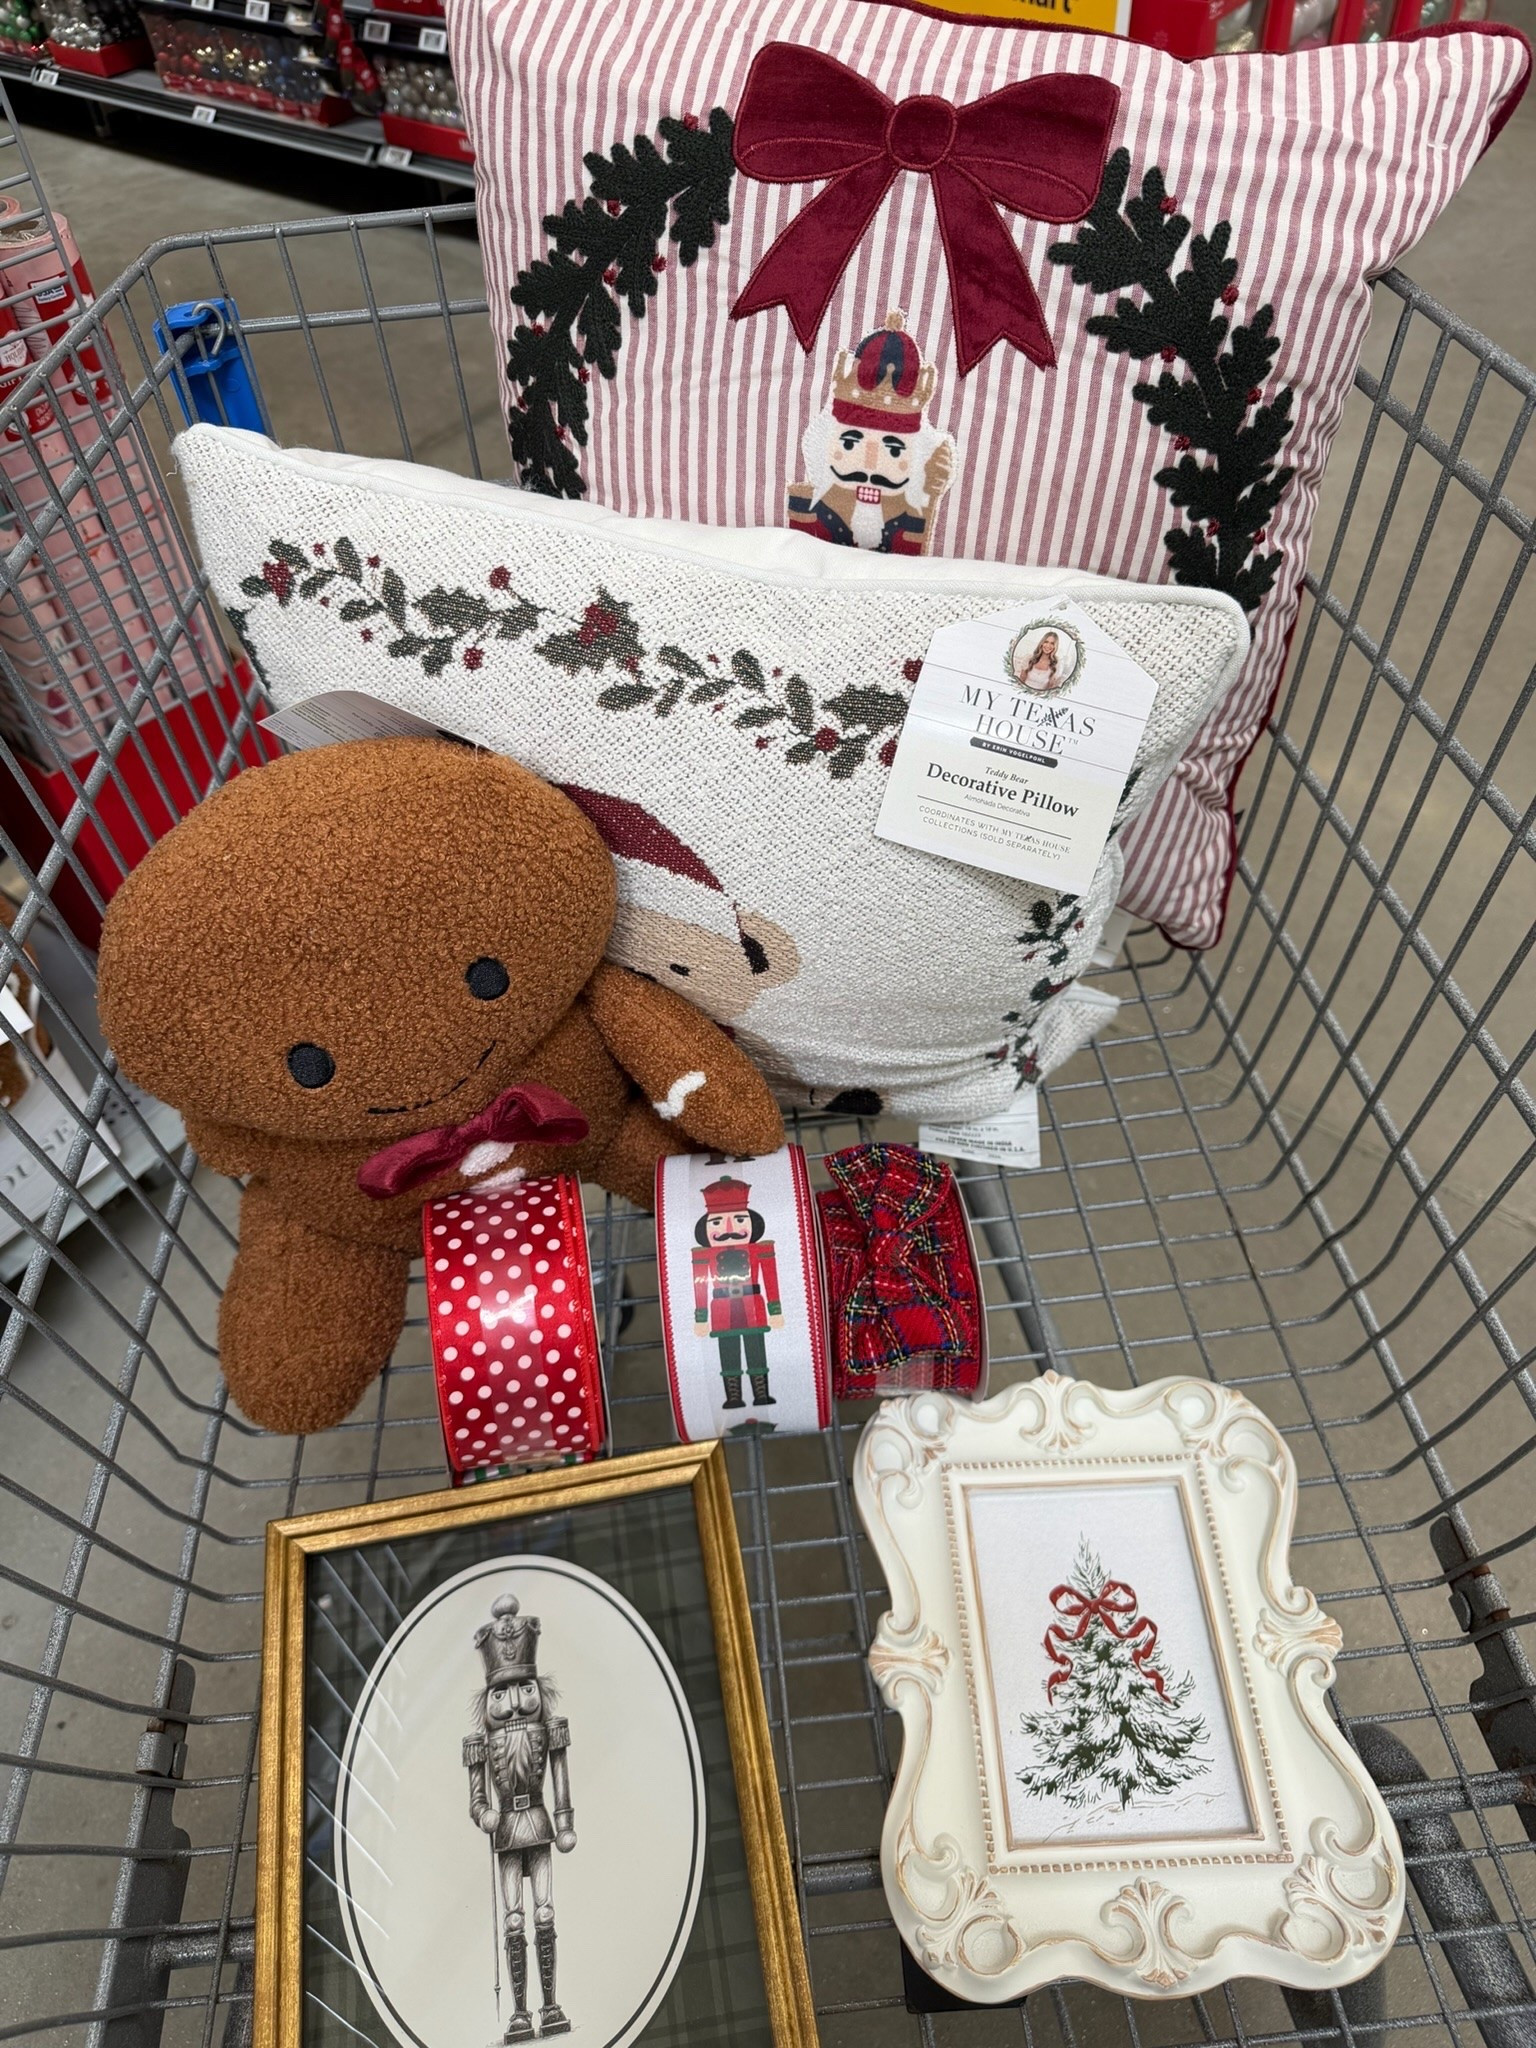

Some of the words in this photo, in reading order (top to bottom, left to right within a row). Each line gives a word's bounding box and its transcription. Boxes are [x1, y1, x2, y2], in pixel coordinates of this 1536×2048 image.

[959, 684, 1002, 711] MY
[1010, 697, 1096, 737] TEXAS
[985, 766, 1009, 780] Teddy
[1010, 773, 1029, 784] Bear
[992, 743, 1007, 753] ERIN
[1009, 748, 1046, 763] VOGELPOHL
[926, 762, 1017, 800] Decorative
[1021, 789, 1079, 817] Pillow
[964, 794, 997, 808] Almohada
[997, 802, 1031, 817] Decorativa
[919, 805, 976, 827] COORDINATES
[977, 821, 999, 833] WITH
[1001, 828, 1014, 838] MY
[1015, 832, 1040, 845] TEXAS
[1042, 840, 1071, 854] HOUSE
[923, 816, 978, 838] COLLECTIONS
[979, 832, 1004, 845] (SOLD
[1006, 839, 1061, 861] SEPARATELY)
